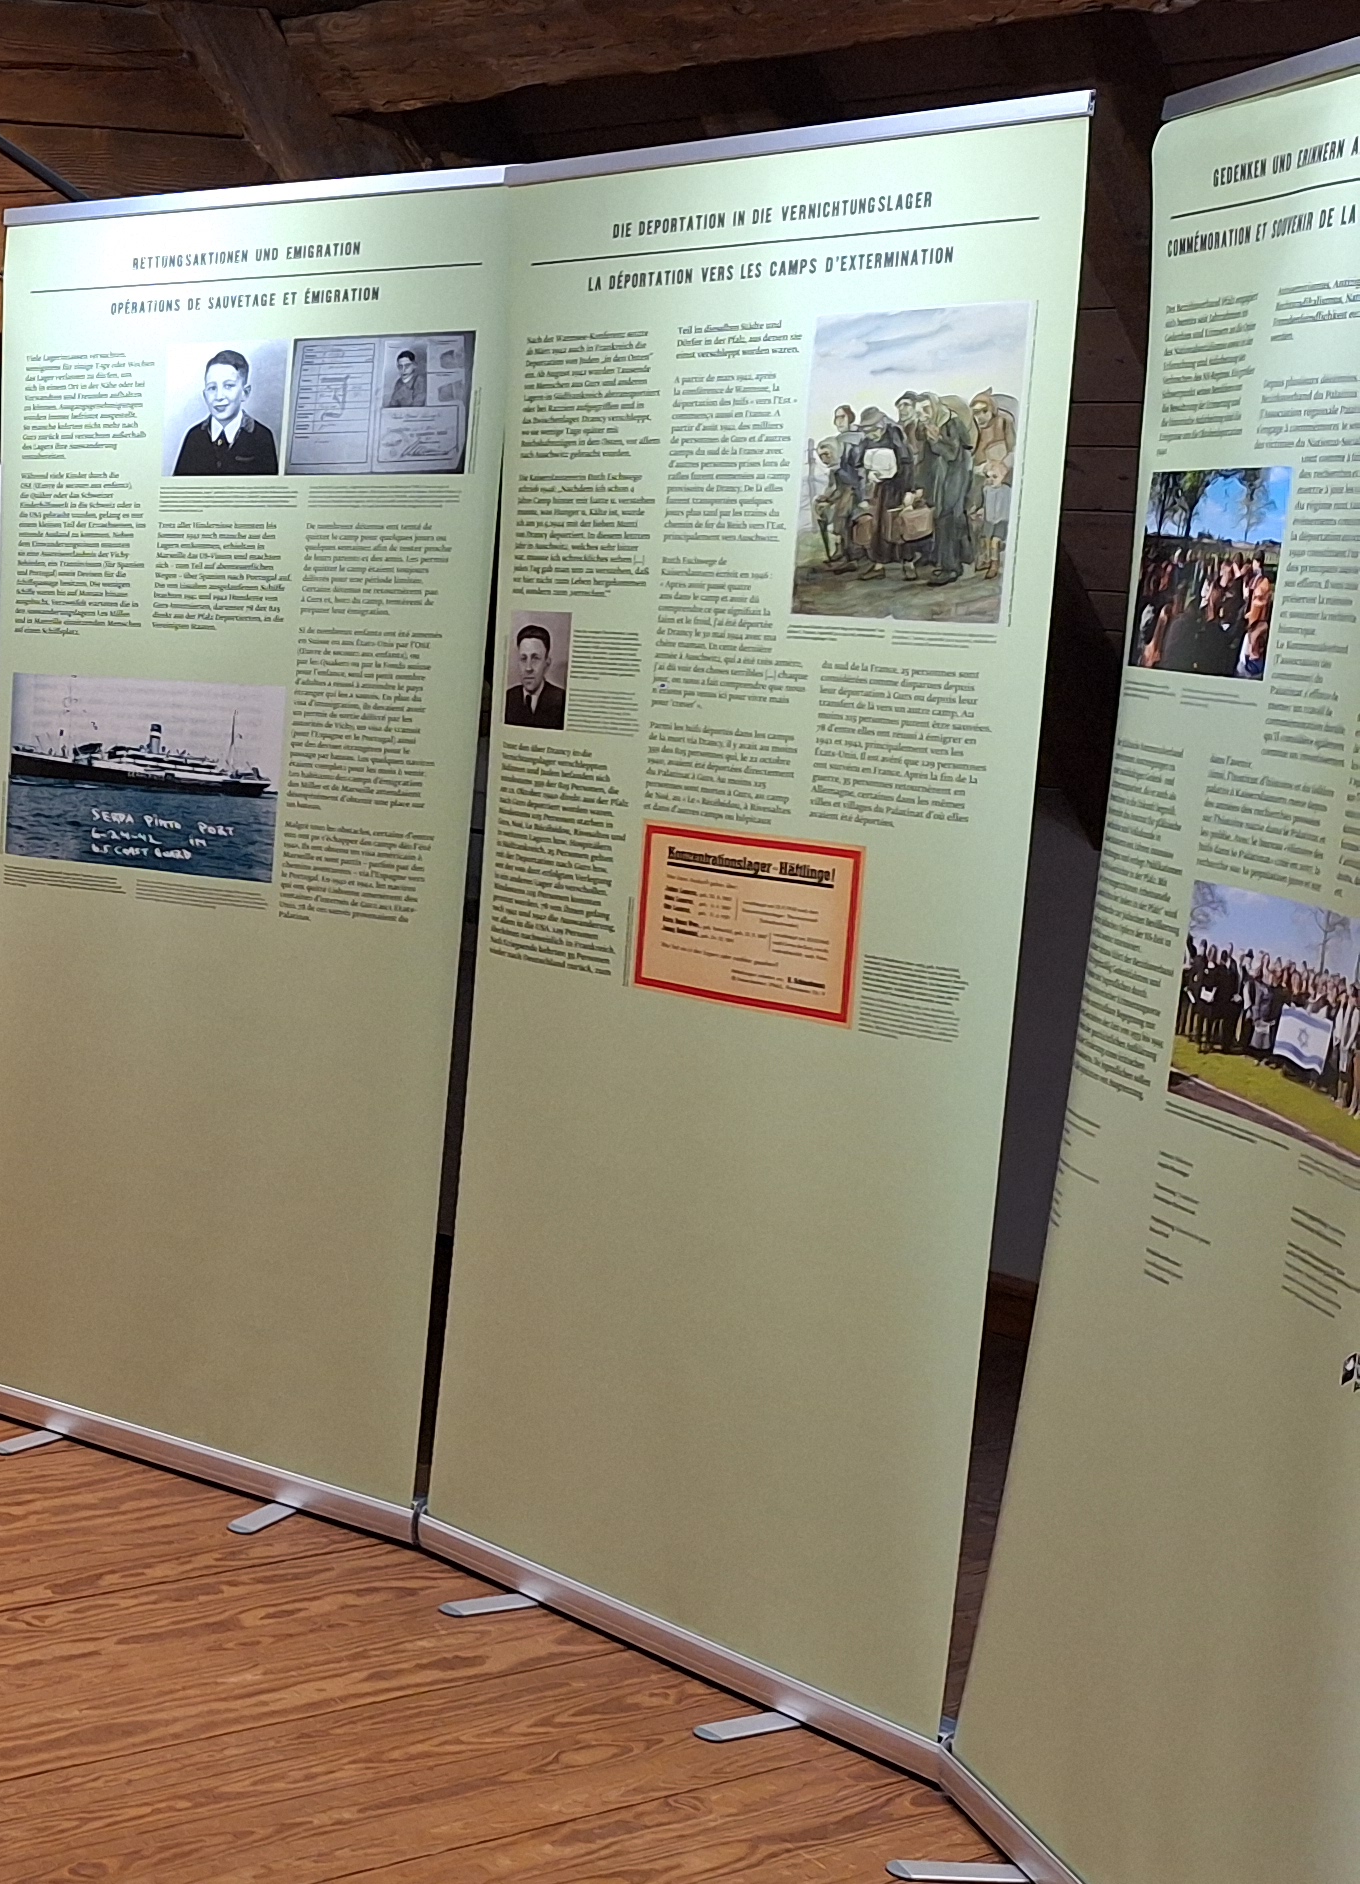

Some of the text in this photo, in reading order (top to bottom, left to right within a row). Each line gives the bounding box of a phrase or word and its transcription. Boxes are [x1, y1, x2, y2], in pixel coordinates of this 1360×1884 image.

[1213, 136, 1360, 188] GEDENKEN UND ERINNERN A
[613, 190, 932, 238] DIE DEPORTATION IN DIE VERNICHTUNGSLAGER
[1168, 204, 1355, 258] COMMÉMORATION ET SOUVENIR DE LA
[133, 241, 360, 270] RETTUNGSAKTIONEN UND EMIGRATION
[588, 246, 953, 292] LA DÉPORTATION VERS LES CAMPS D'EXTERMINATION
[111, 282, 379, 315] OPÉRATIONS DE SAUVETAGE ET ÉMIGRATION
[820, 685, 836, 695] leur
